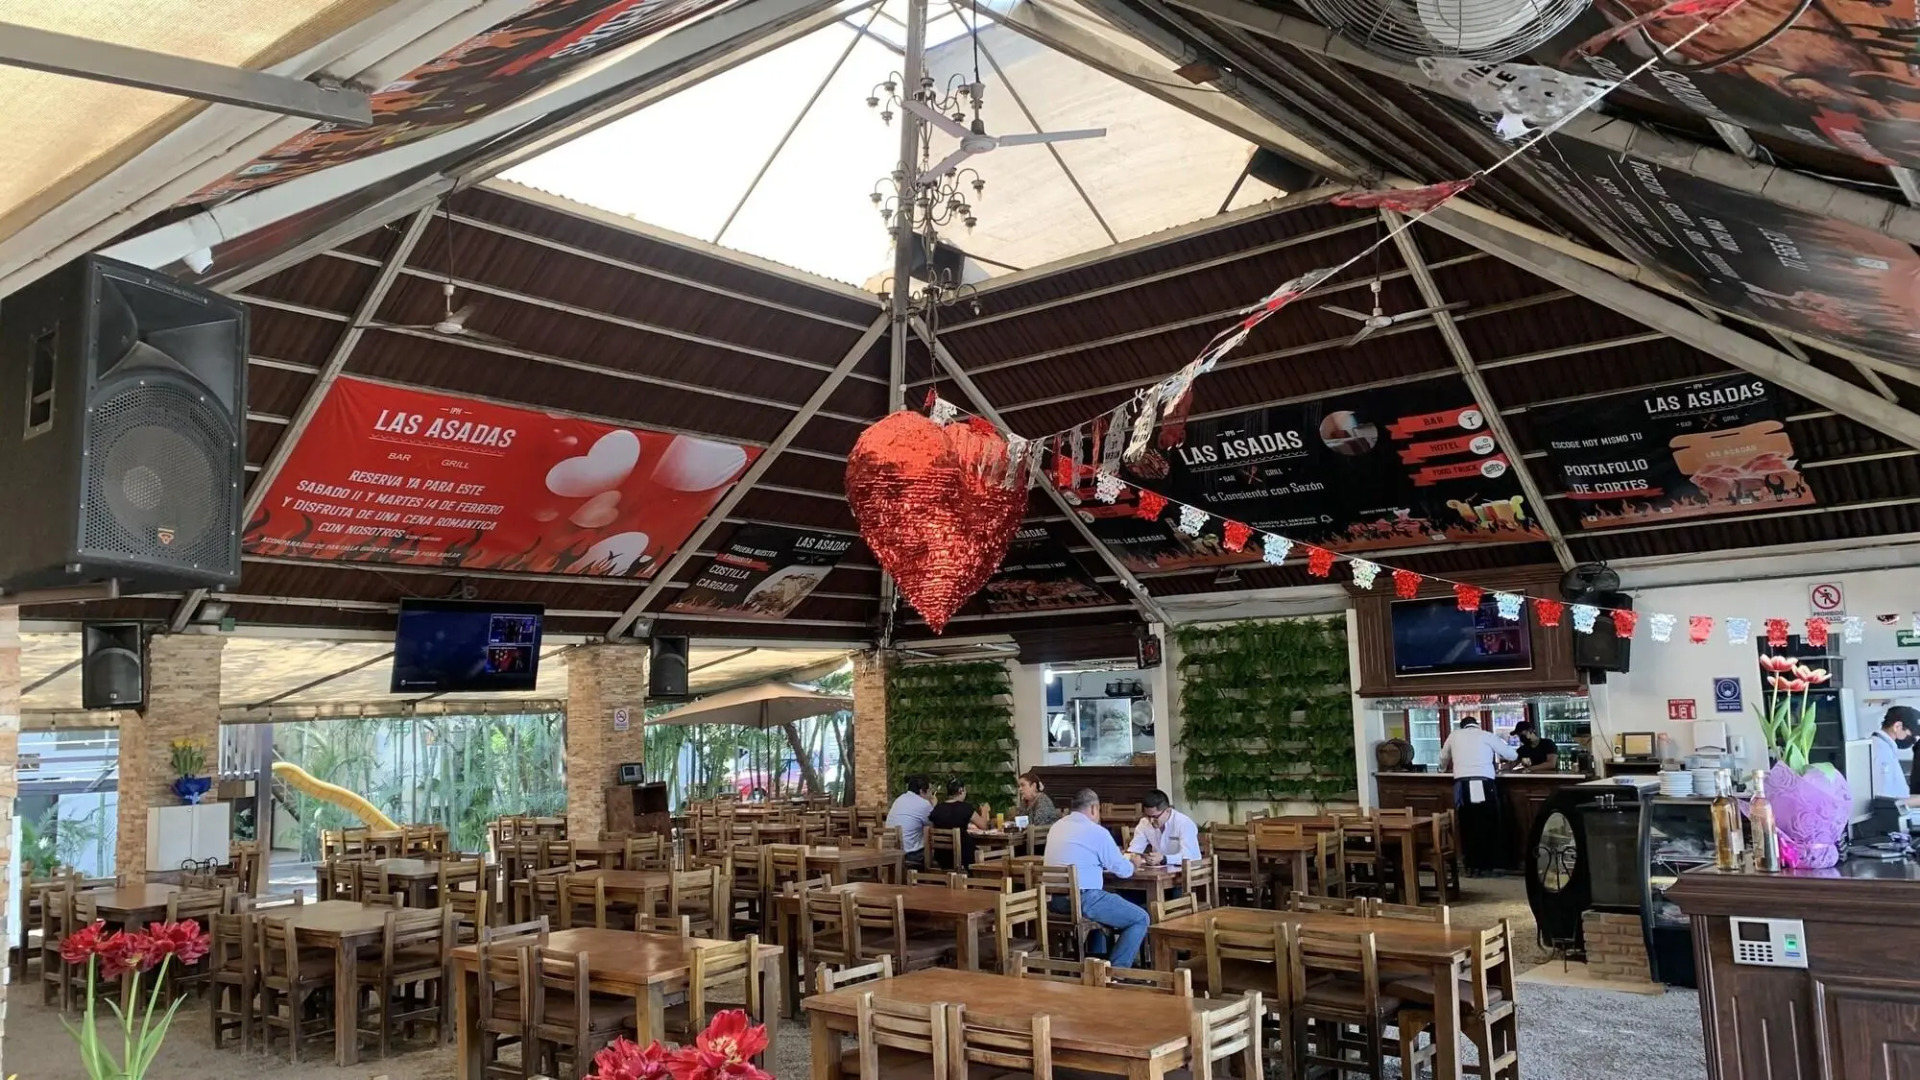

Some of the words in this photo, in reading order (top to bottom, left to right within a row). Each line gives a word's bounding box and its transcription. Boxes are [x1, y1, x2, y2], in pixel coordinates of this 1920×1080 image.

[1644, 396, 1680, 414] LAS
[1688, 381, 1766, 409] ASADAS
[374, 410, 422, 434] LAS
[424, 418, 517, 448] ASADAS
[1424, 416, 1444, 426] BAR
[1178, 446, 1218, 466] LAS
[1222, 430, 1303, 460] ASADAS
[1430, 443, 1460, 452] HOTEL
[1552, 440, 1582, 449] ESCOGE
[1582, 438, 1600, 447] HOY
[1601, 435, 1629, 446] MISMO
[1630, 432, 1644, 442] TU
[387, 452, 412, 462] BAR
[441, 459, 470, 470] GRILL
[1564, 458, 1649, 477] PORTAFOLIO
[1265, 468, 1284, 477] GRILL
[1432, 467, 1452, 476] FOOD
[1454, 464, 1478, 474] TRUCK
[348, 470, 400, 488] RESERVA
[406, 477, 420, 490] YA
[422, 480, 453, 492] PARA
[456, 483, 486, 496] ESTE
[1572, 483, 1592, 495] DE
[1596, 478, 1649, 494] CORTES
[296, 480, 351, 500] SABADO
[364, 492, 375, 502] Y
[376, 492, 424, 508] MARTES
[424, 497, 436, 509] 14
[440, 500, 455, 511] DE
[454, 502, 504, 516] FEBRERO
[1203, 493, 1218, 502] Te
[1218, 489, 1268, 502] Consiente
[1270, 488, 1290, 496] con
[1290, 481, 1324, 493] Sazón
[280, 496, 292, 508] Y
[292, 499, 352, 518] DISFRUTA
[355, 509, 373, 520] DE
[375, 511, 400, 523] UNA
[402, 514, 433, 526] CENA
[436, 517, 498, 532] ROMANTICA
[318, 522, 346, 534] CON
[345, 524, 406, 538] NOSOTROS
[1014, 528, 1048, 539] ASADAS
[796, 536, 816, 548] LAS
[814, 538, 852, 552] ASADAS
[1138, 534, 1167, 543] ASADAS
[731, 544, 754, 556] PRUEBA
[708, 564, 751, 580] COSTILLA
[696, 578, 739, 592] CARGADA
